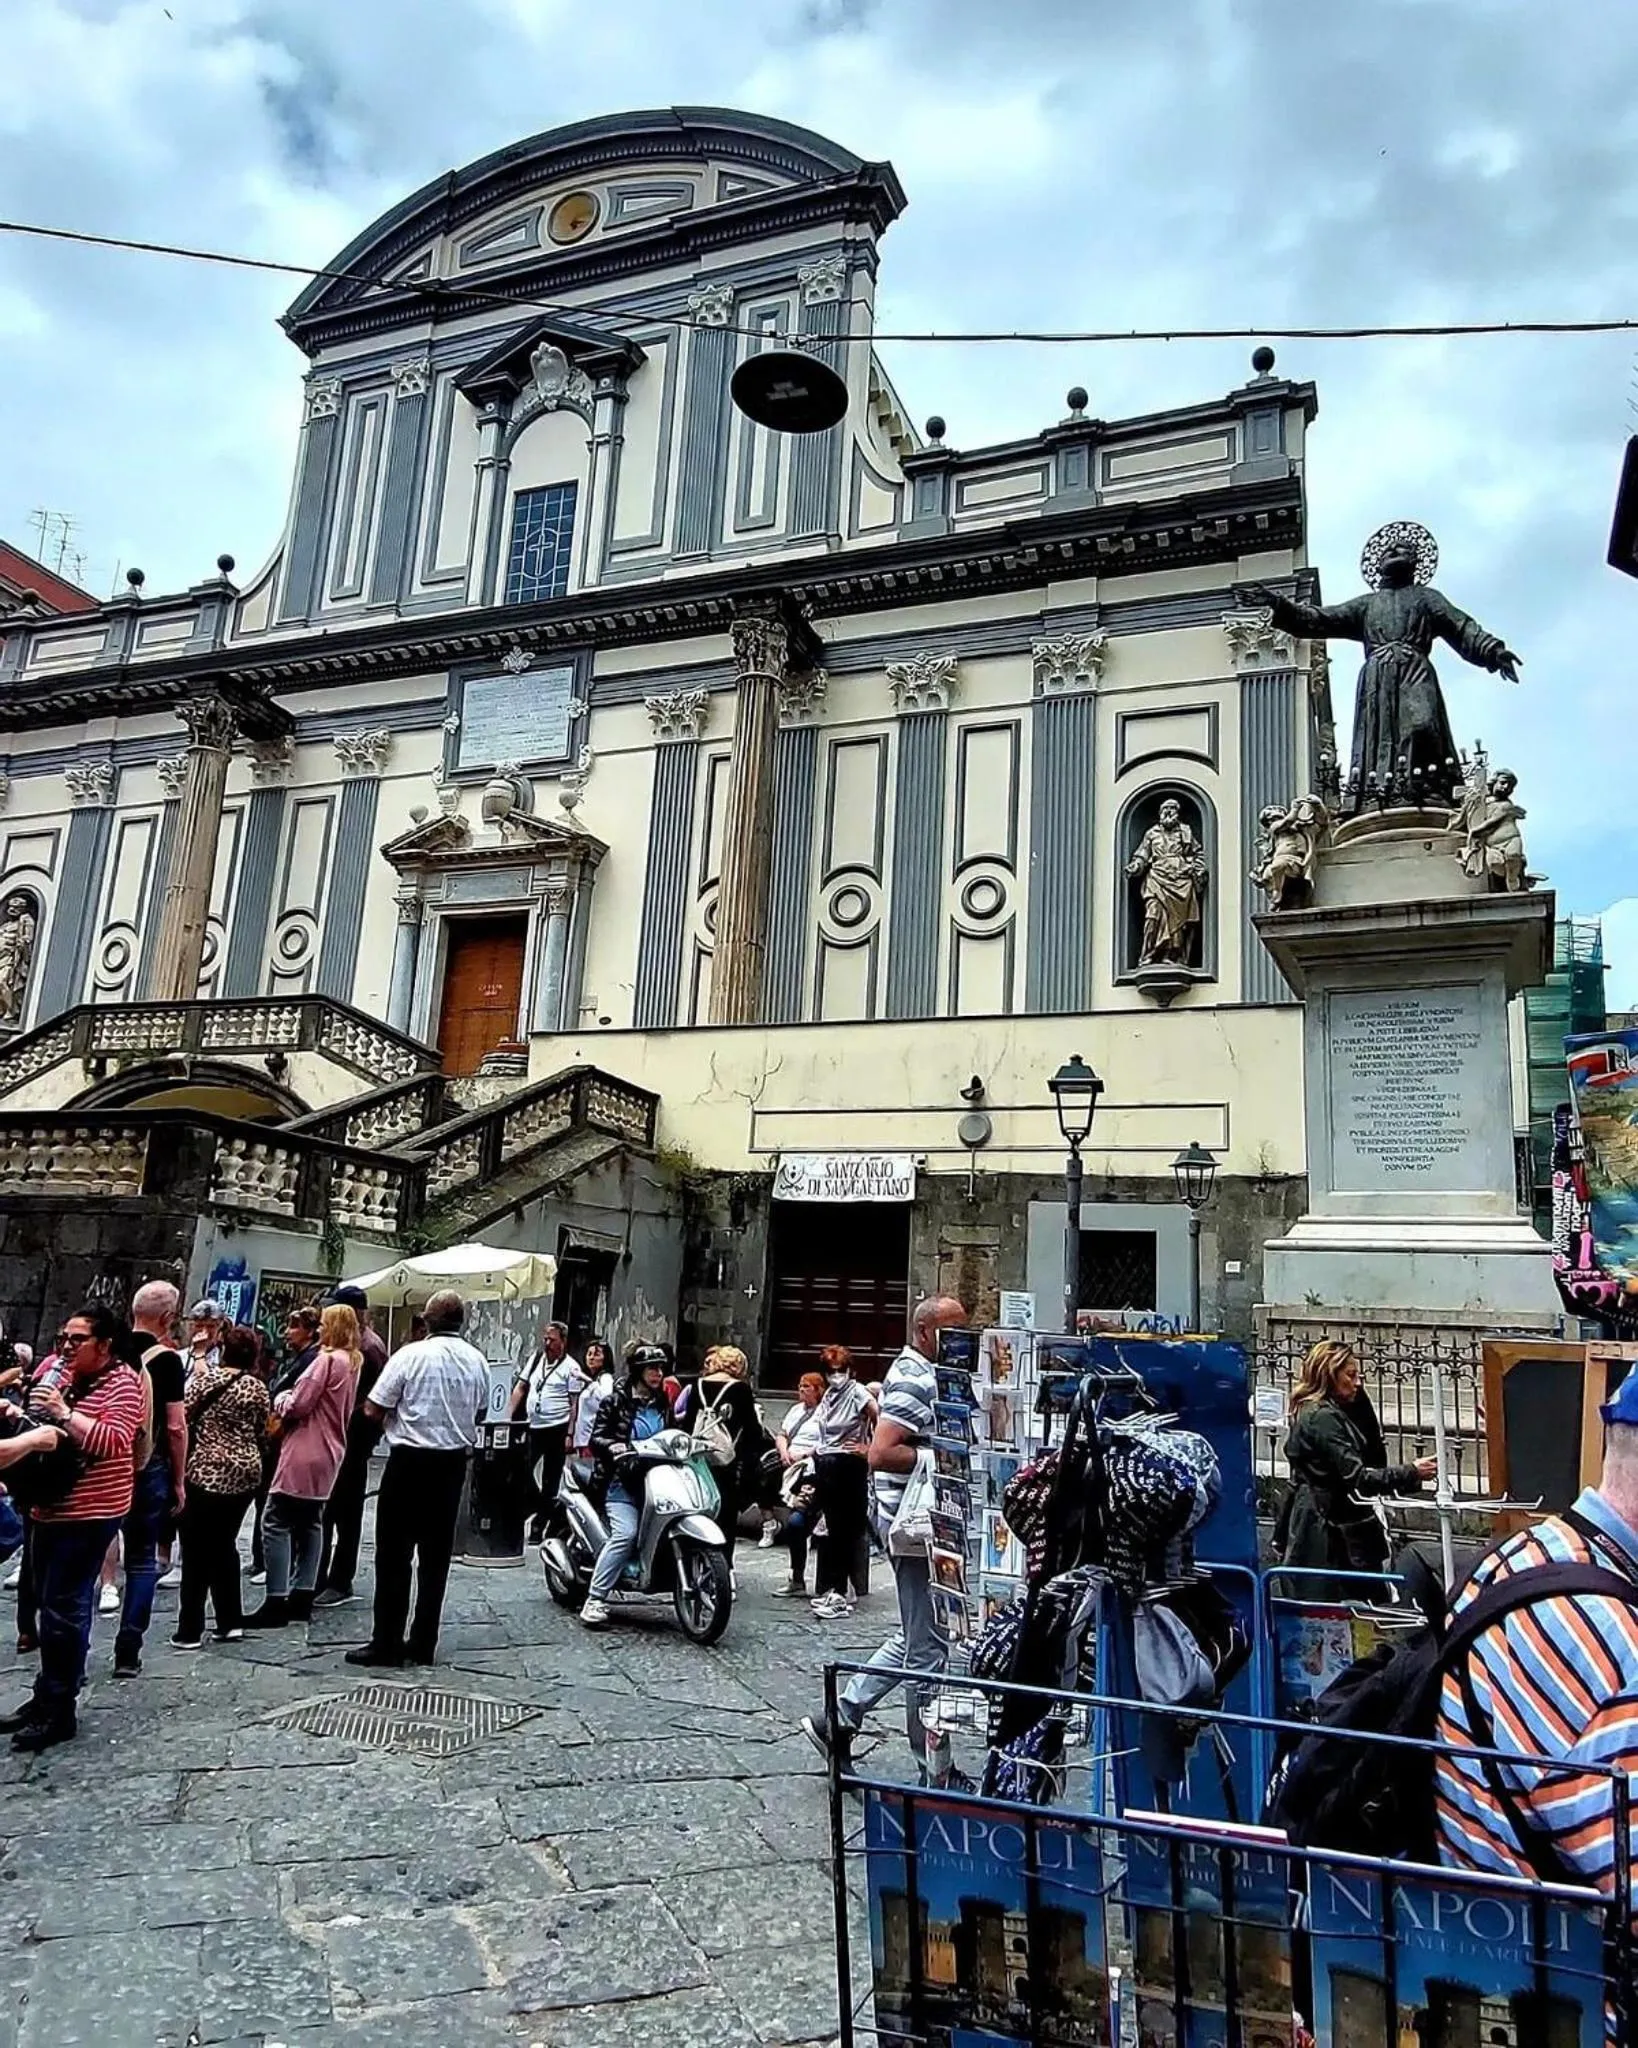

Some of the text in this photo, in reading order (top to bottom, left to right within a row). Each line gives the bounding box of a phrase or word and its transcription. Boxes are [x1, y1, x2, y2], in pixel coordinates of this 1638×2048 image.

[807, 1179, 821, 1196] DI
[878, 1805, 1077, 1872] NAPOLI
[1327, 1872, 1573, 1952] NAPOLI
